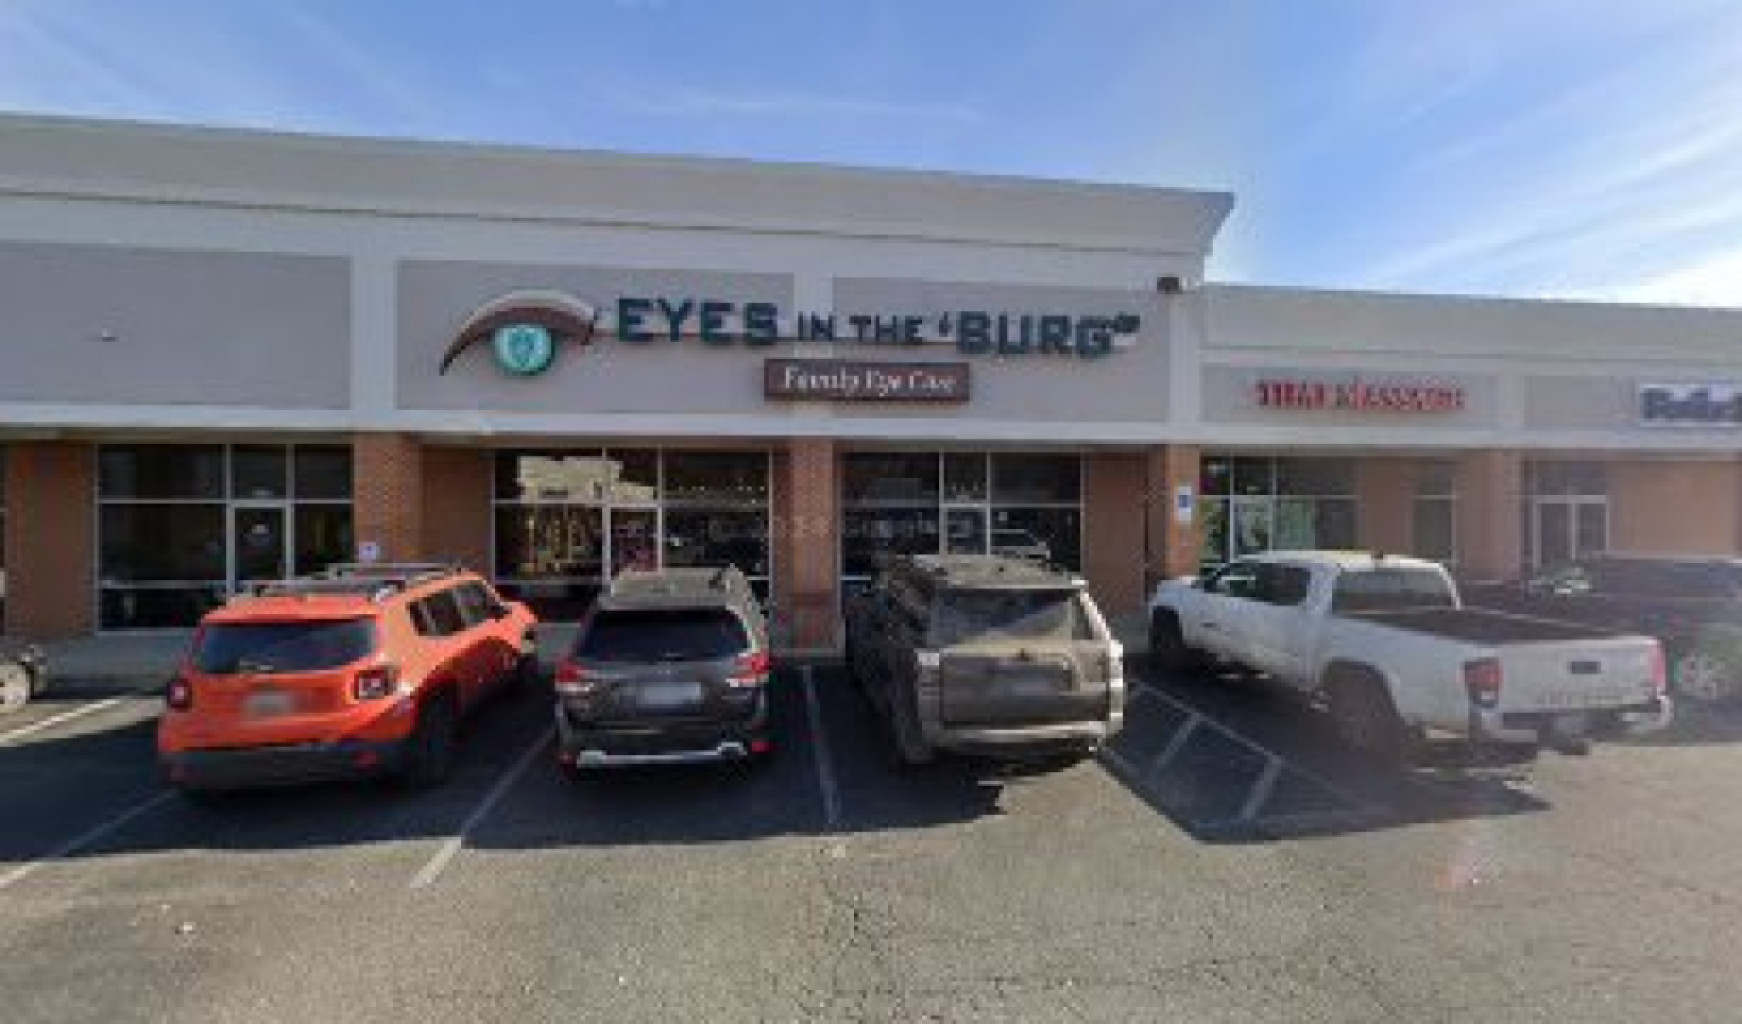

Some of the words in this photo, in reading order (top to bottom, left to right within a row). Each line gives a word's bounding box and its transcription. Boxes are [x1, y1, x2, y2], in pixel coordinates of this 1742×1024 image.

[617, 297, 779, 346] EYES
[799, 310, 835, 342] IN
[849, 313, 923, 344] THE
[784, 366, 860, 397] Family
